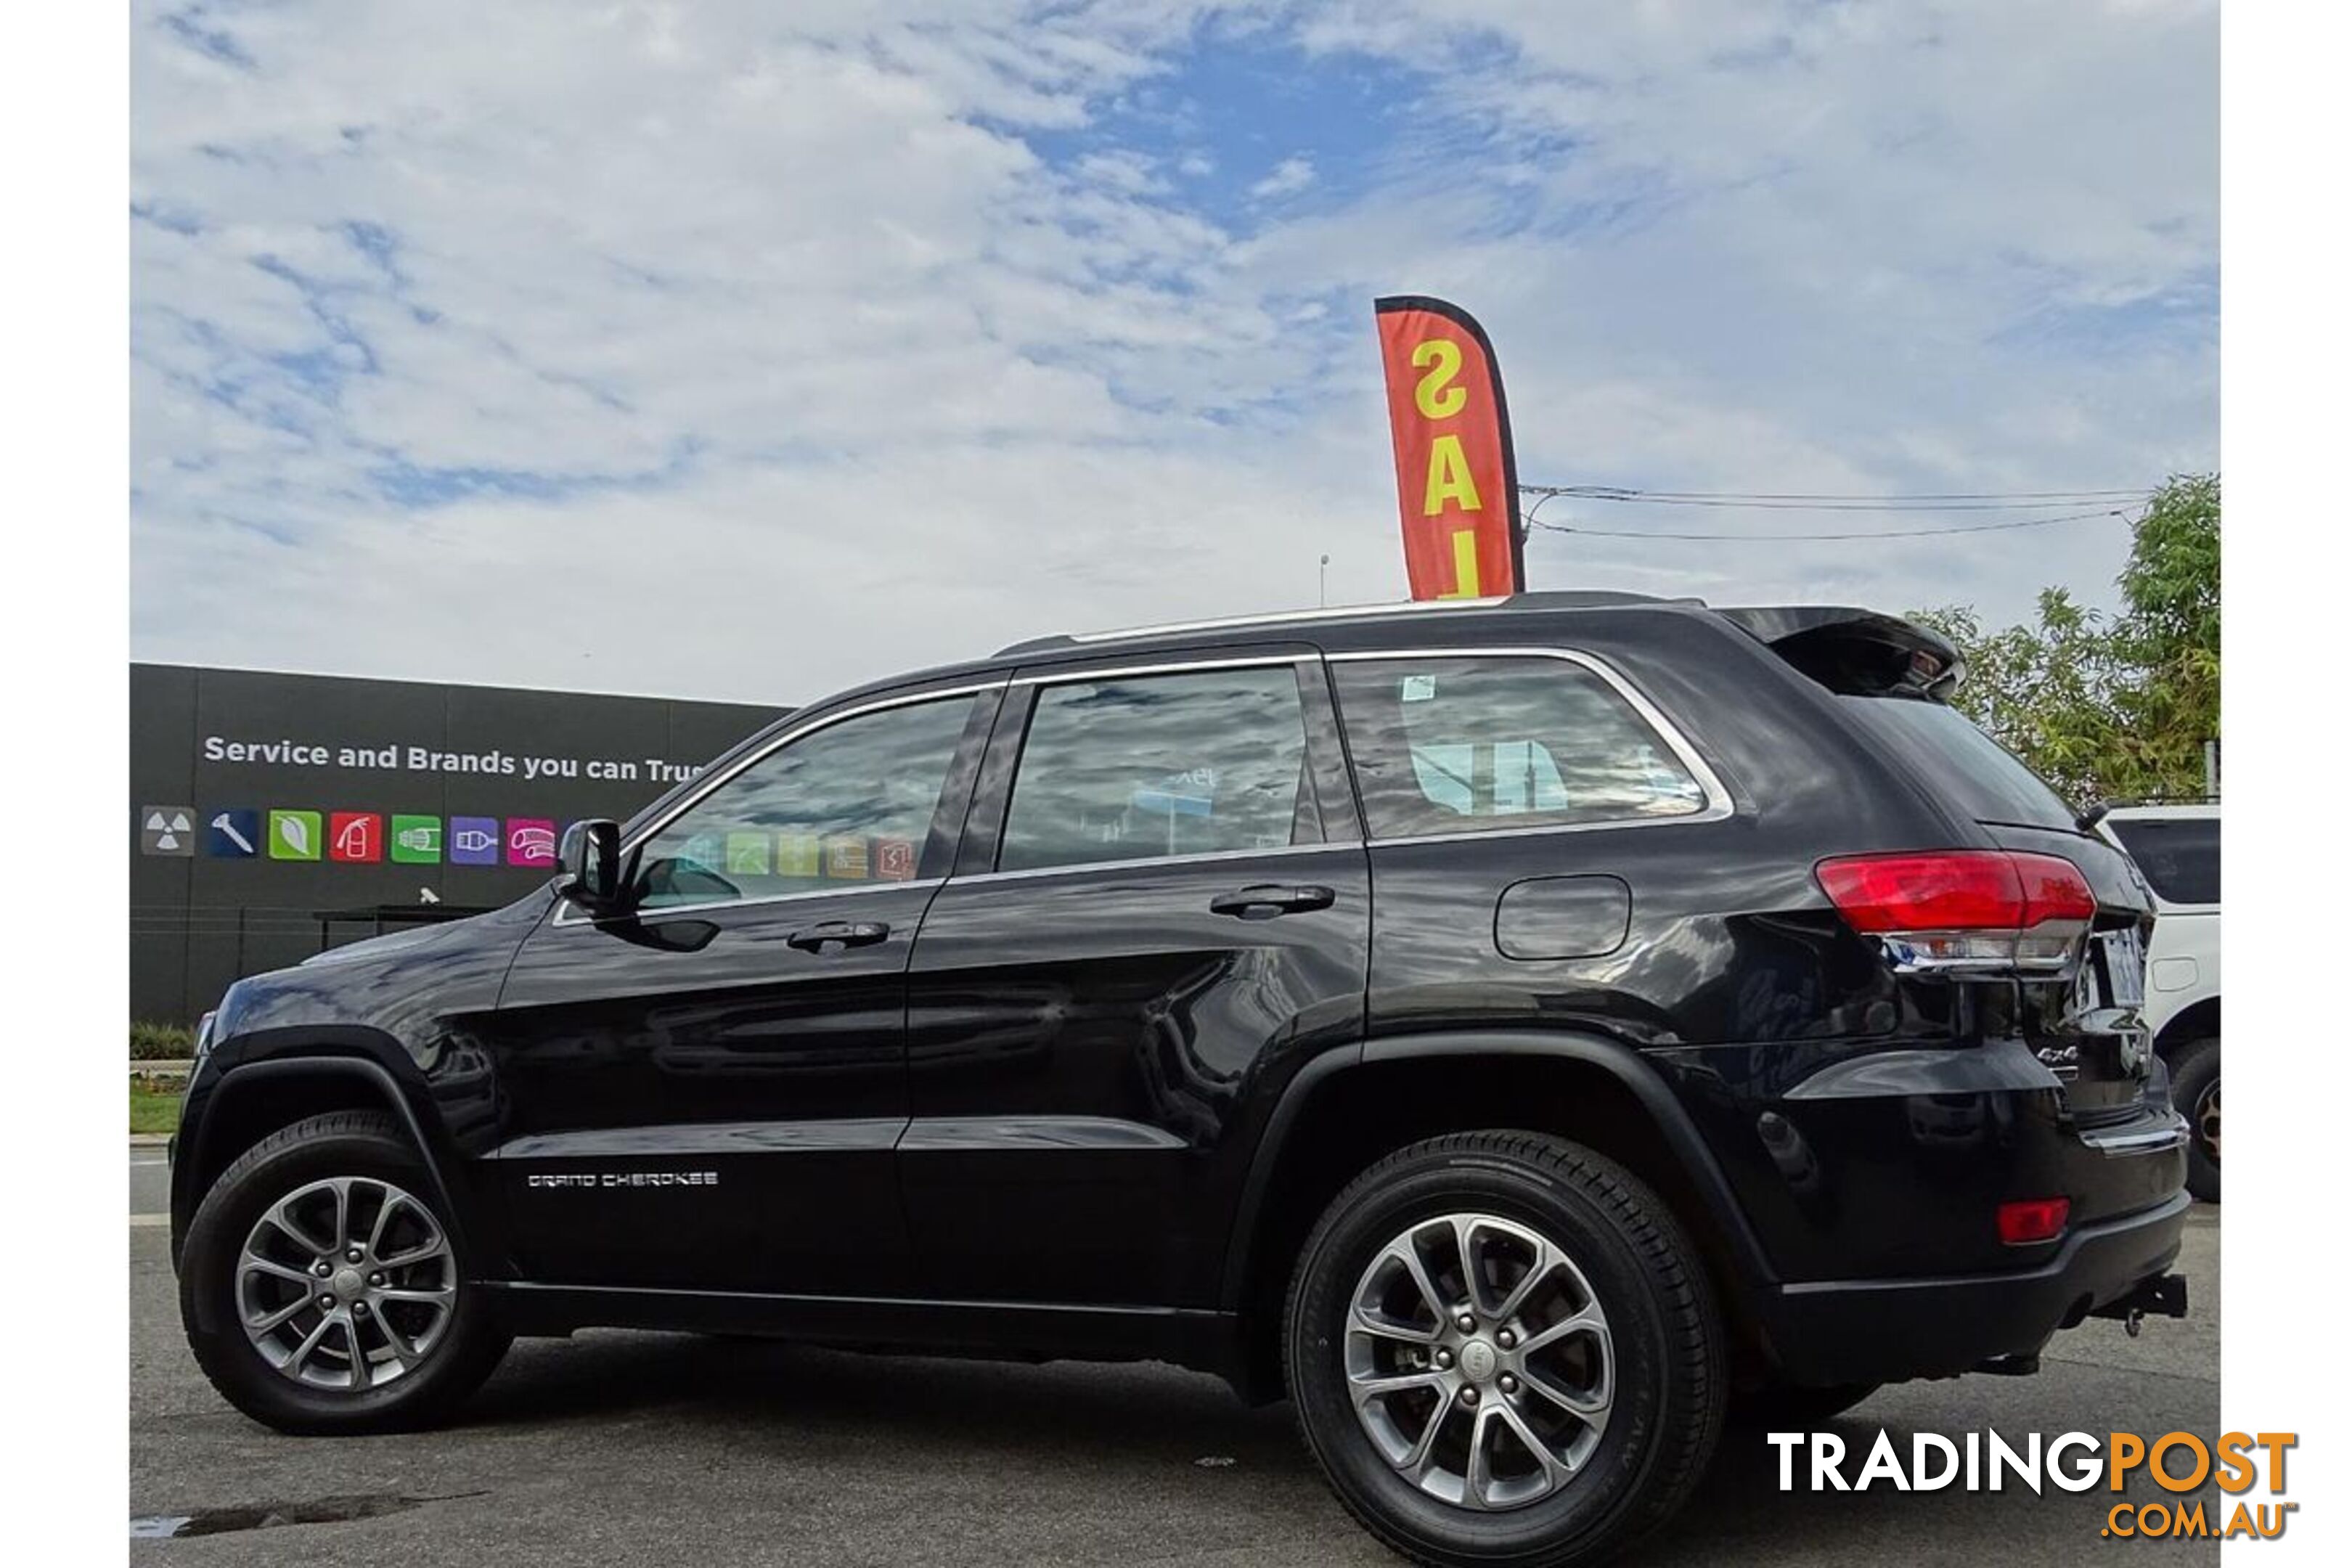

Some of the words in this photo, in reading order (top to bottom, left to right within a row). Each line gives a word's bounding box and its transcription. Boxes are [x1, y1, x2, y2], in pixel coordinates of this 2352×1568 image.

[204, 736, 330, 765] Service
[338, 745, 398, 769] and
[407, 747, 516, 774] Brands
[523, 756, 578, 780] you
[586, 761, 637, 780] can
[528, 1175, 597, 1187] GRAND
[601, 1172, 719, 1186] CHEROKEE
